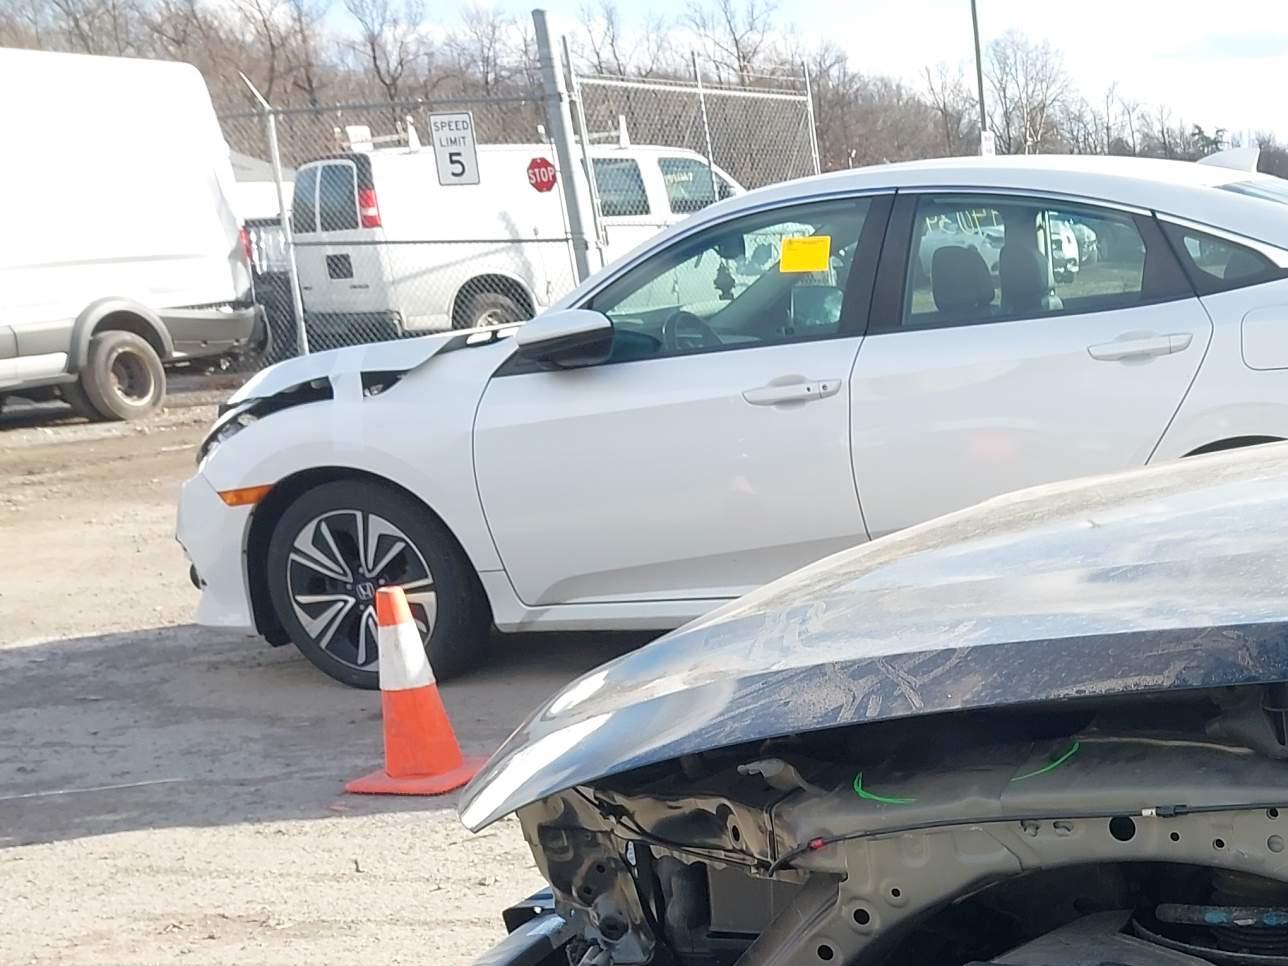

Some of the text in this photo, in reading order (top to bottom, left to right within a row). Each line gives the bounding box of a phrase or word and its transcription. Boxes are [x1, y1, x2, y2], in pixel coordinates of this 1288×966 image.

[433, 120, 469, 131] SPEED
[440, 136, 467, 147] LIMIT
[448, 152, 466, 177] 5
[528, 167, 555, 184] STOP
